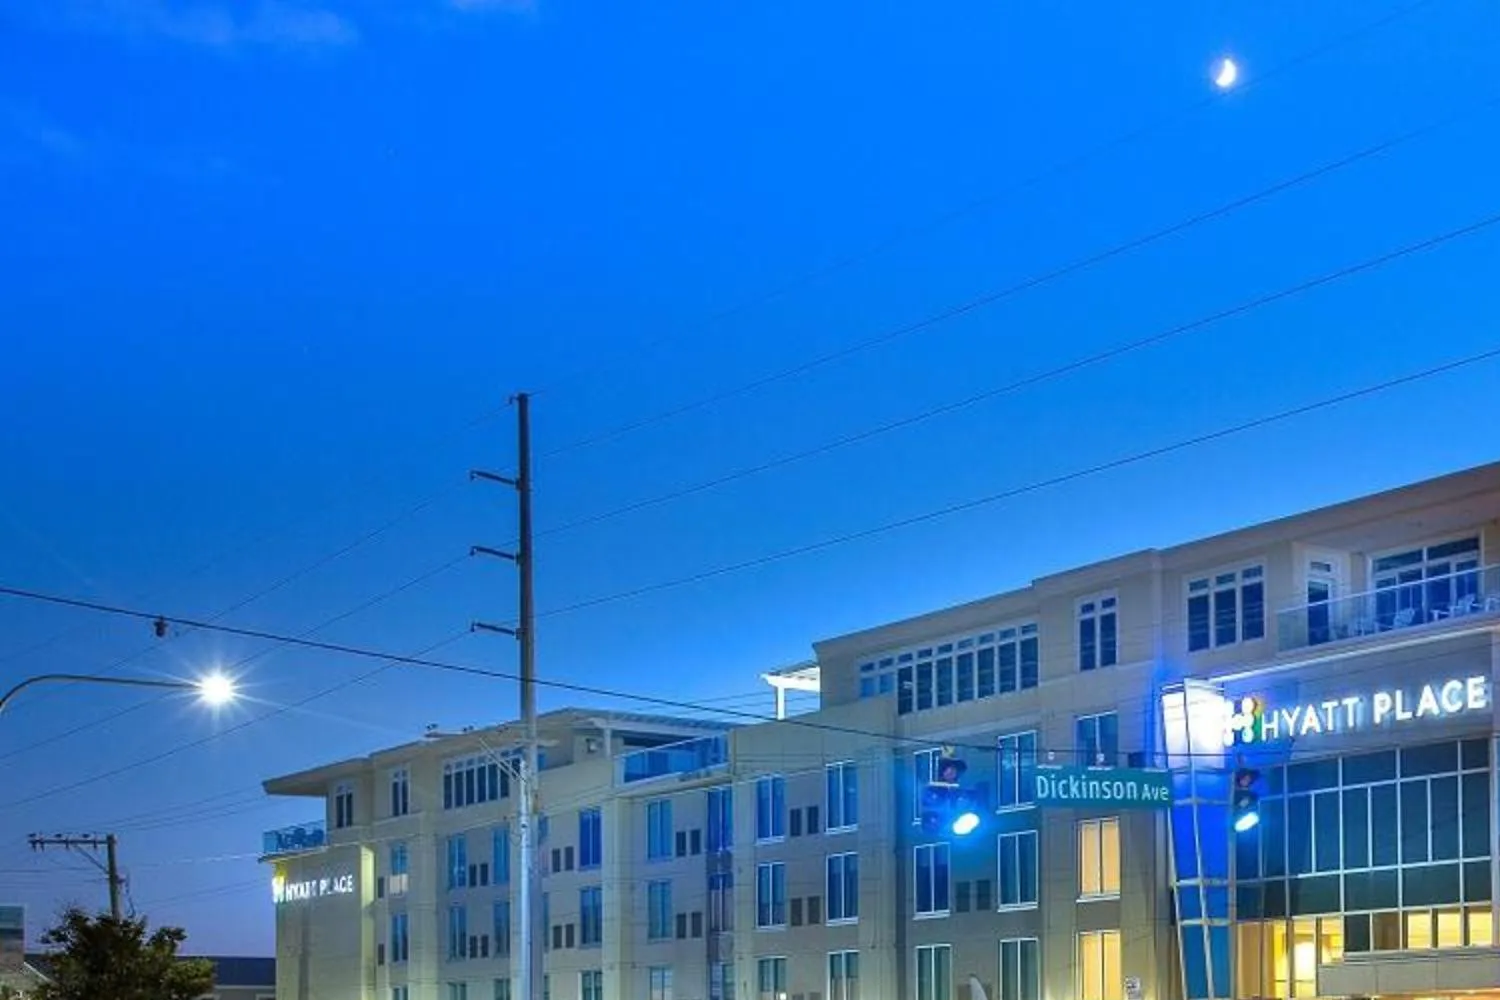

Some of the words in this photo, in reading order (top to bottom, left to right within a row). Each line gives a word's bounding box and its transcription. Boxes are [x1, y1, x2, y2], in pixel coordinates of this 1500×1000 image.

[1261, 696, 1360, 741] HYATT
[1373, 675, 1486, 724] PLACE
[1036, 774, 1138, 799] Dickinson
[1141, 783, 1170, 801] Ave
[319, 874, 353, 897] PLACE
